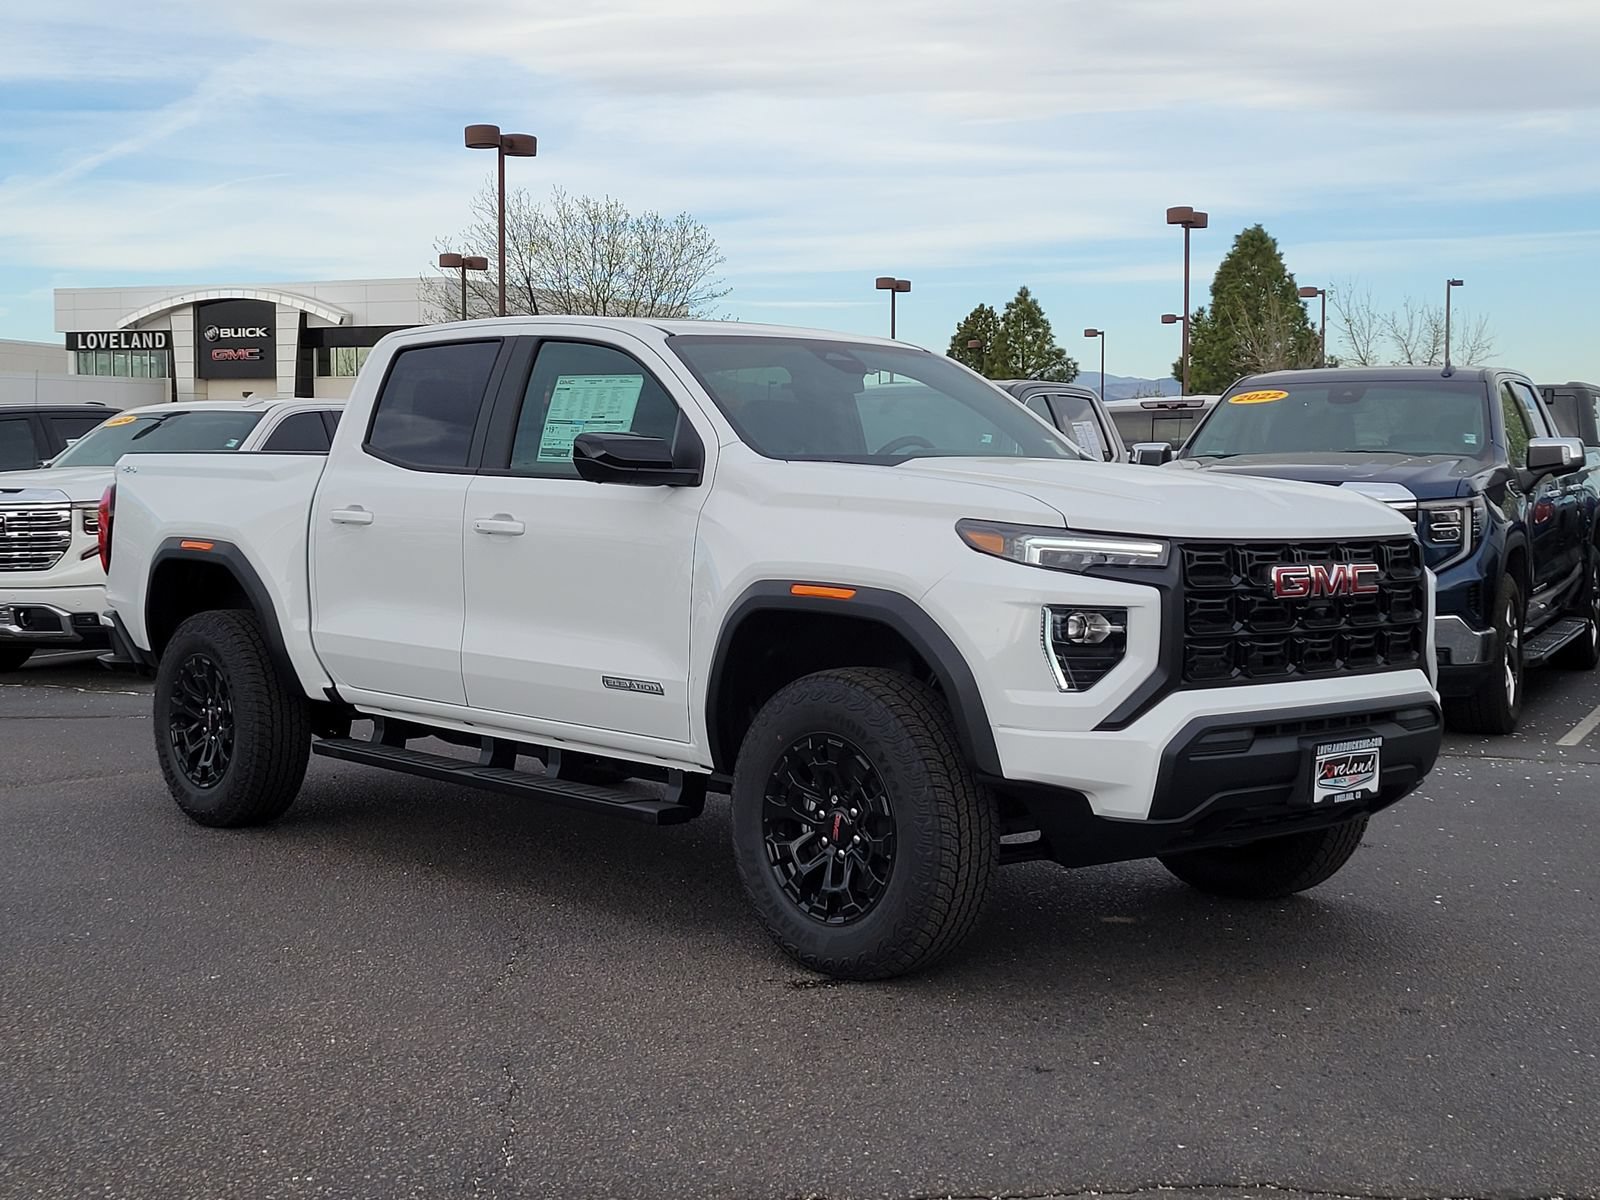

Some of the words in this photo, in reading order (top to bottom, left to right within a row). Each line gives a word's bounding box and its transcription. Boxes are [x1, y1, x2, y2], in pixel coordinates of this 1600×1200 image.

[219, 327, 268, 338] BUICK
[77, 332, 167, 349] LOVELAND
[212, 348, 260, 361] GMC
[1233, 391, 1284, 402] 2022
[1271, 564, 1379, 599] GMC
[605, 679, 659, 692] ELEVATION
